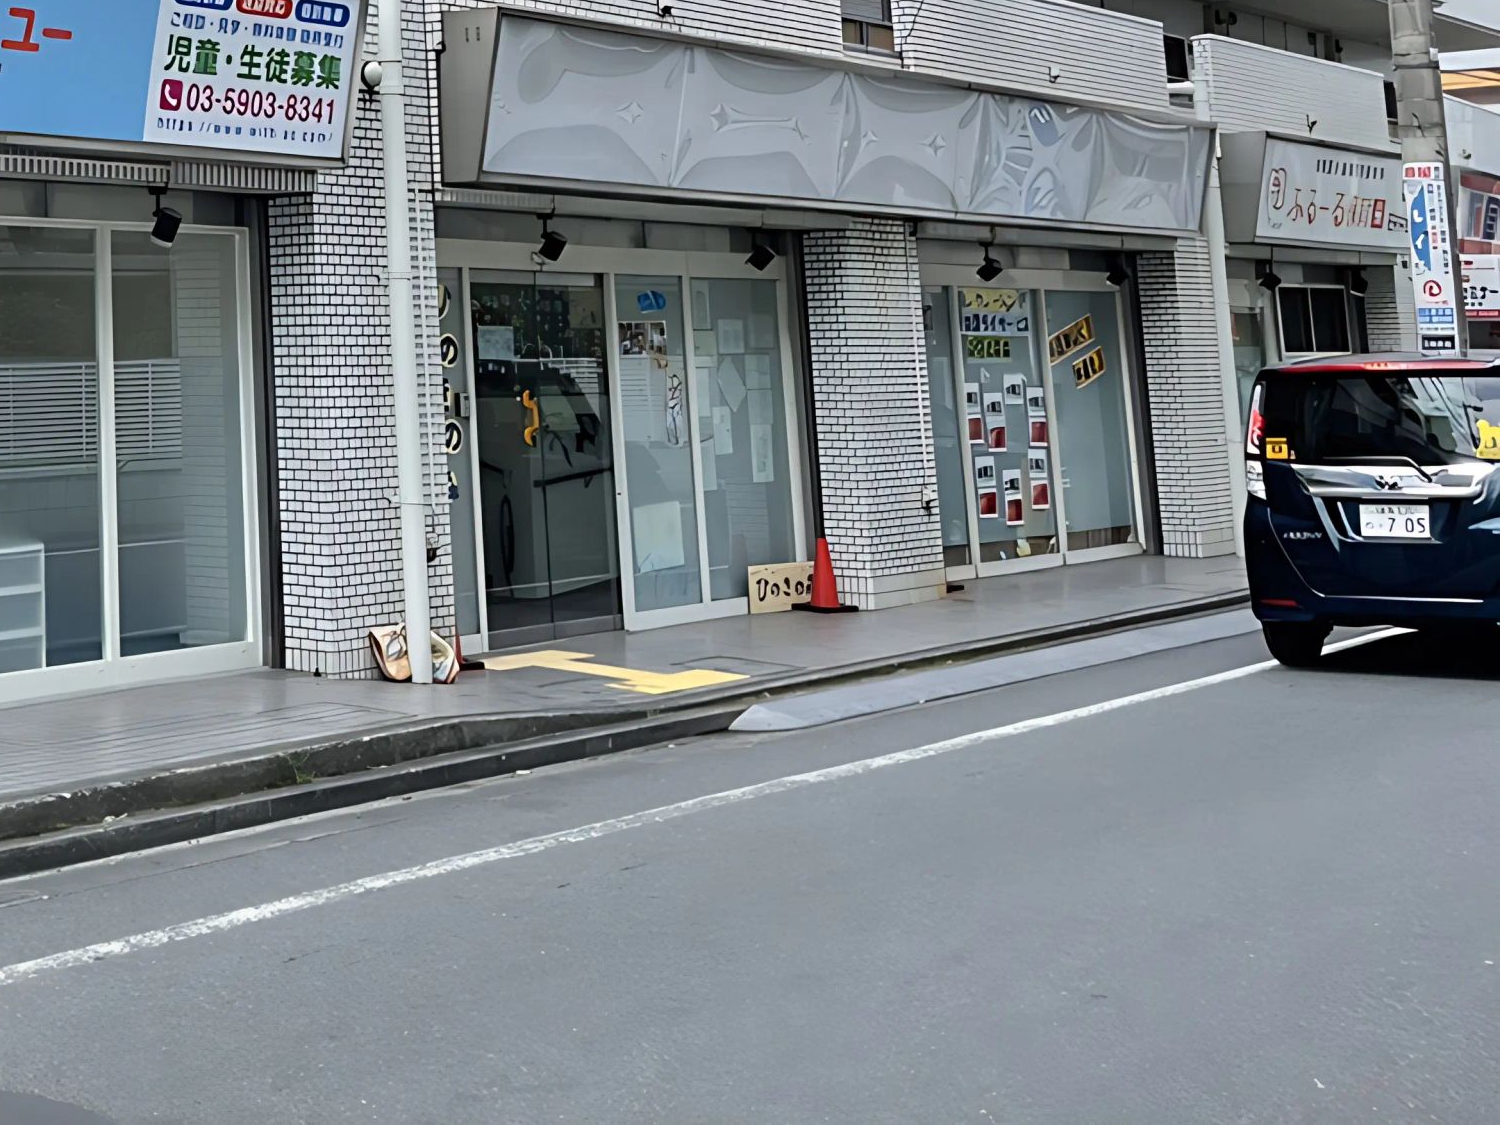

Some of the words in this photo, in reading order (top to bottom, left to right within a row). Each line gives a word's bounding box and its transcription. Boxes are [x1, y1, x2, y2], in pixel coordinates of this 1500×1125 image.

[163, 34, 342, 90] 児童・生徒募集
[186, 83, 334, 125] 03-5903-8341
